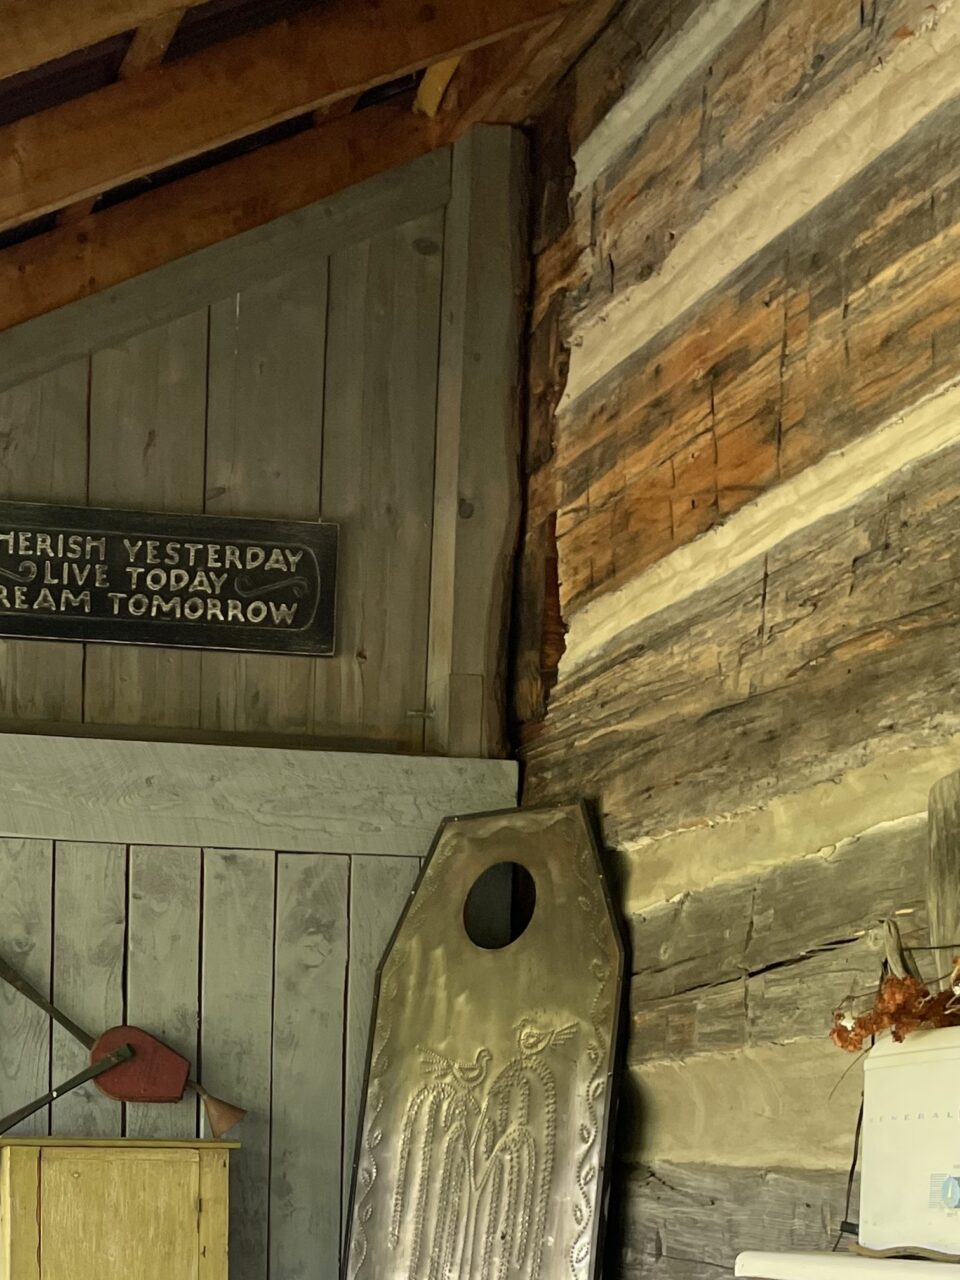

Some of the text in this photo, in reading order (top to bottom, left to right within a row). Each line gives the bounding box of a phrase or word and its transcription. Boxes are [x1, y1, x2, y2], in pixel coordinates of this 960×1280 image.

[122, 538, 304, 573] YESTERDAY
[43, 560, 228, 595] LIVE TODAY
[107, 592, 298, 625] TOMORROW
